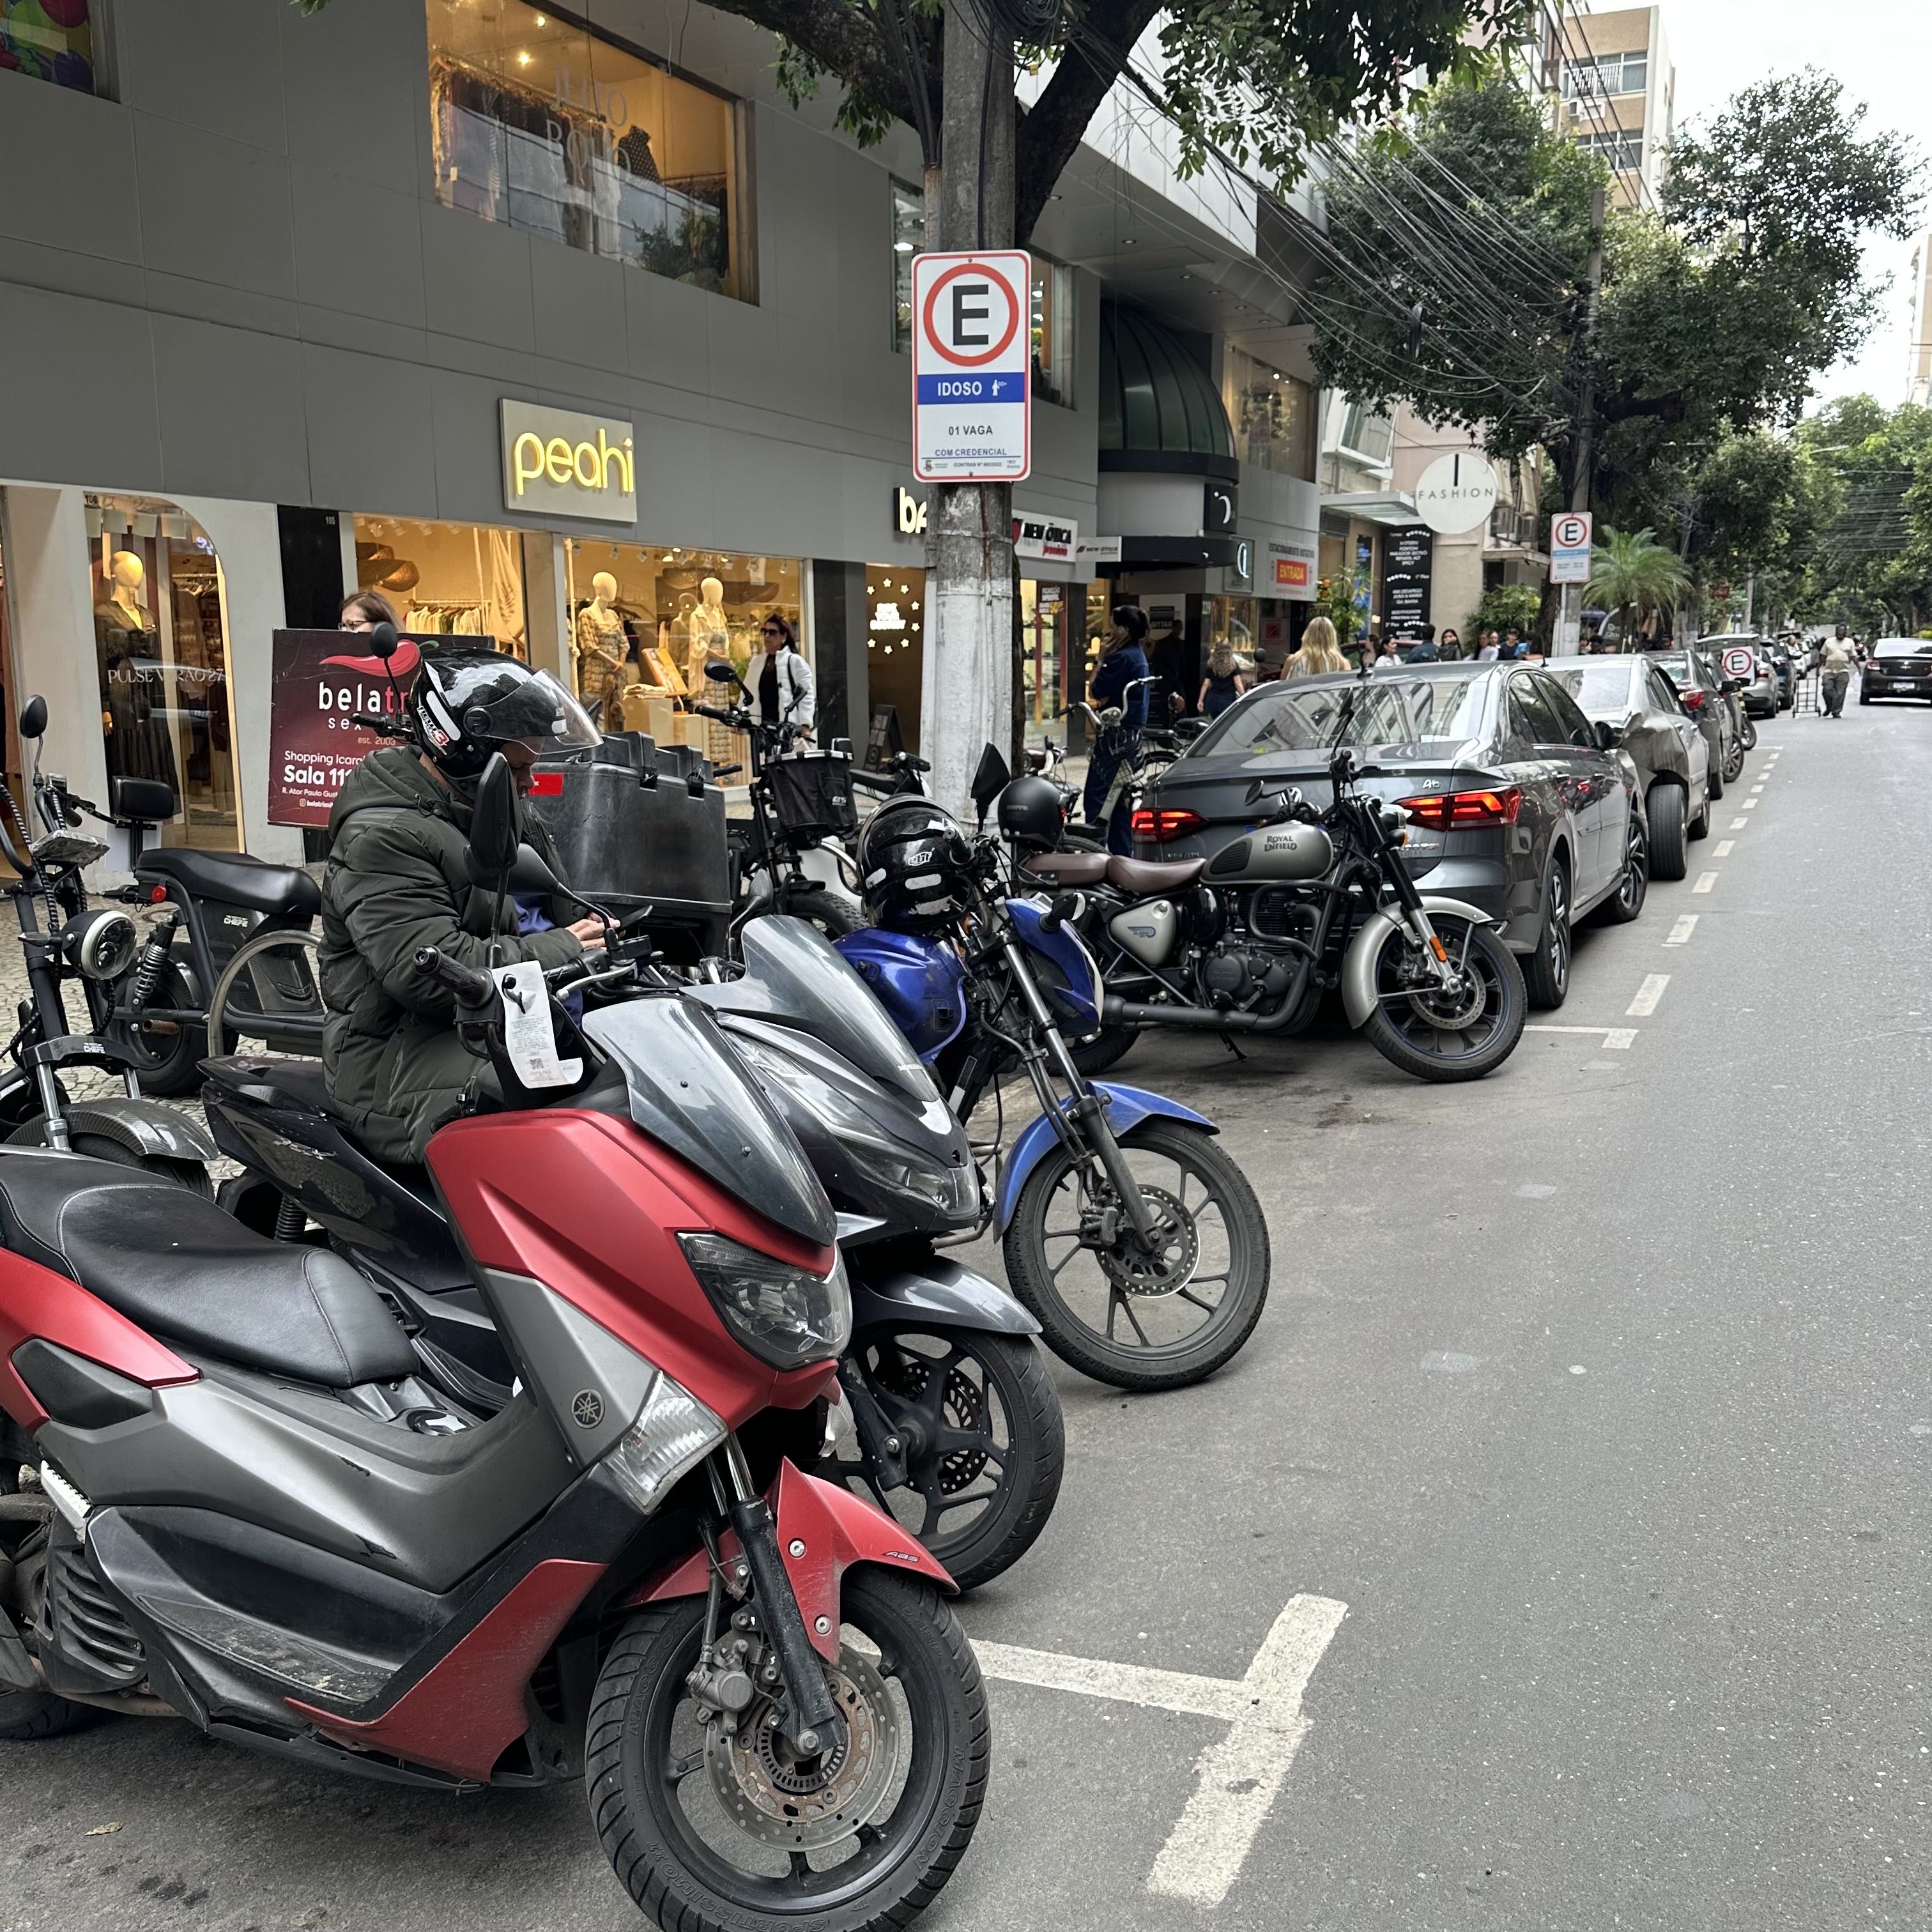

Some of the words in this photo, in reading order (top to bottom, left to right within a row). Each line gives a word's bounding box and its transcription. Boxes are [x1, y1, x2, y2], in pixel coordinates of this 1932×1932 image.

[953, 284, 988, 346] E
[938, 381, 982, 396] IDOSO
[948, 426, 959, 435] 01
[963, 425, 993, 435] VAGA
[515, 428, 634, 495] peahi
[1418, 487, 1494, 500] FASHION
[1565, 523, 1577, 541] E
[1279, 564, 1303, 580] ENTRADA
[1731, 654, 1744, 670] E
[107, 668, 153, 684] PULSE
[319, 681, 409, 713] belatr
[375, 737, 395, 746] 2003
[284, 751, 334, 765] Shopping
[336, 754, 366, 765] Icara
[284, 765, 325, 785] Sala
[303, 788, 322, 797] Paulo
[1264, 843, 1297, 852] ENFIELD
[885, 1551, 919, 1562] ABS
[915, 1745, 966, 1873] MAGGION
[662, 1862, 828, 1932] SPORTISSIMO
